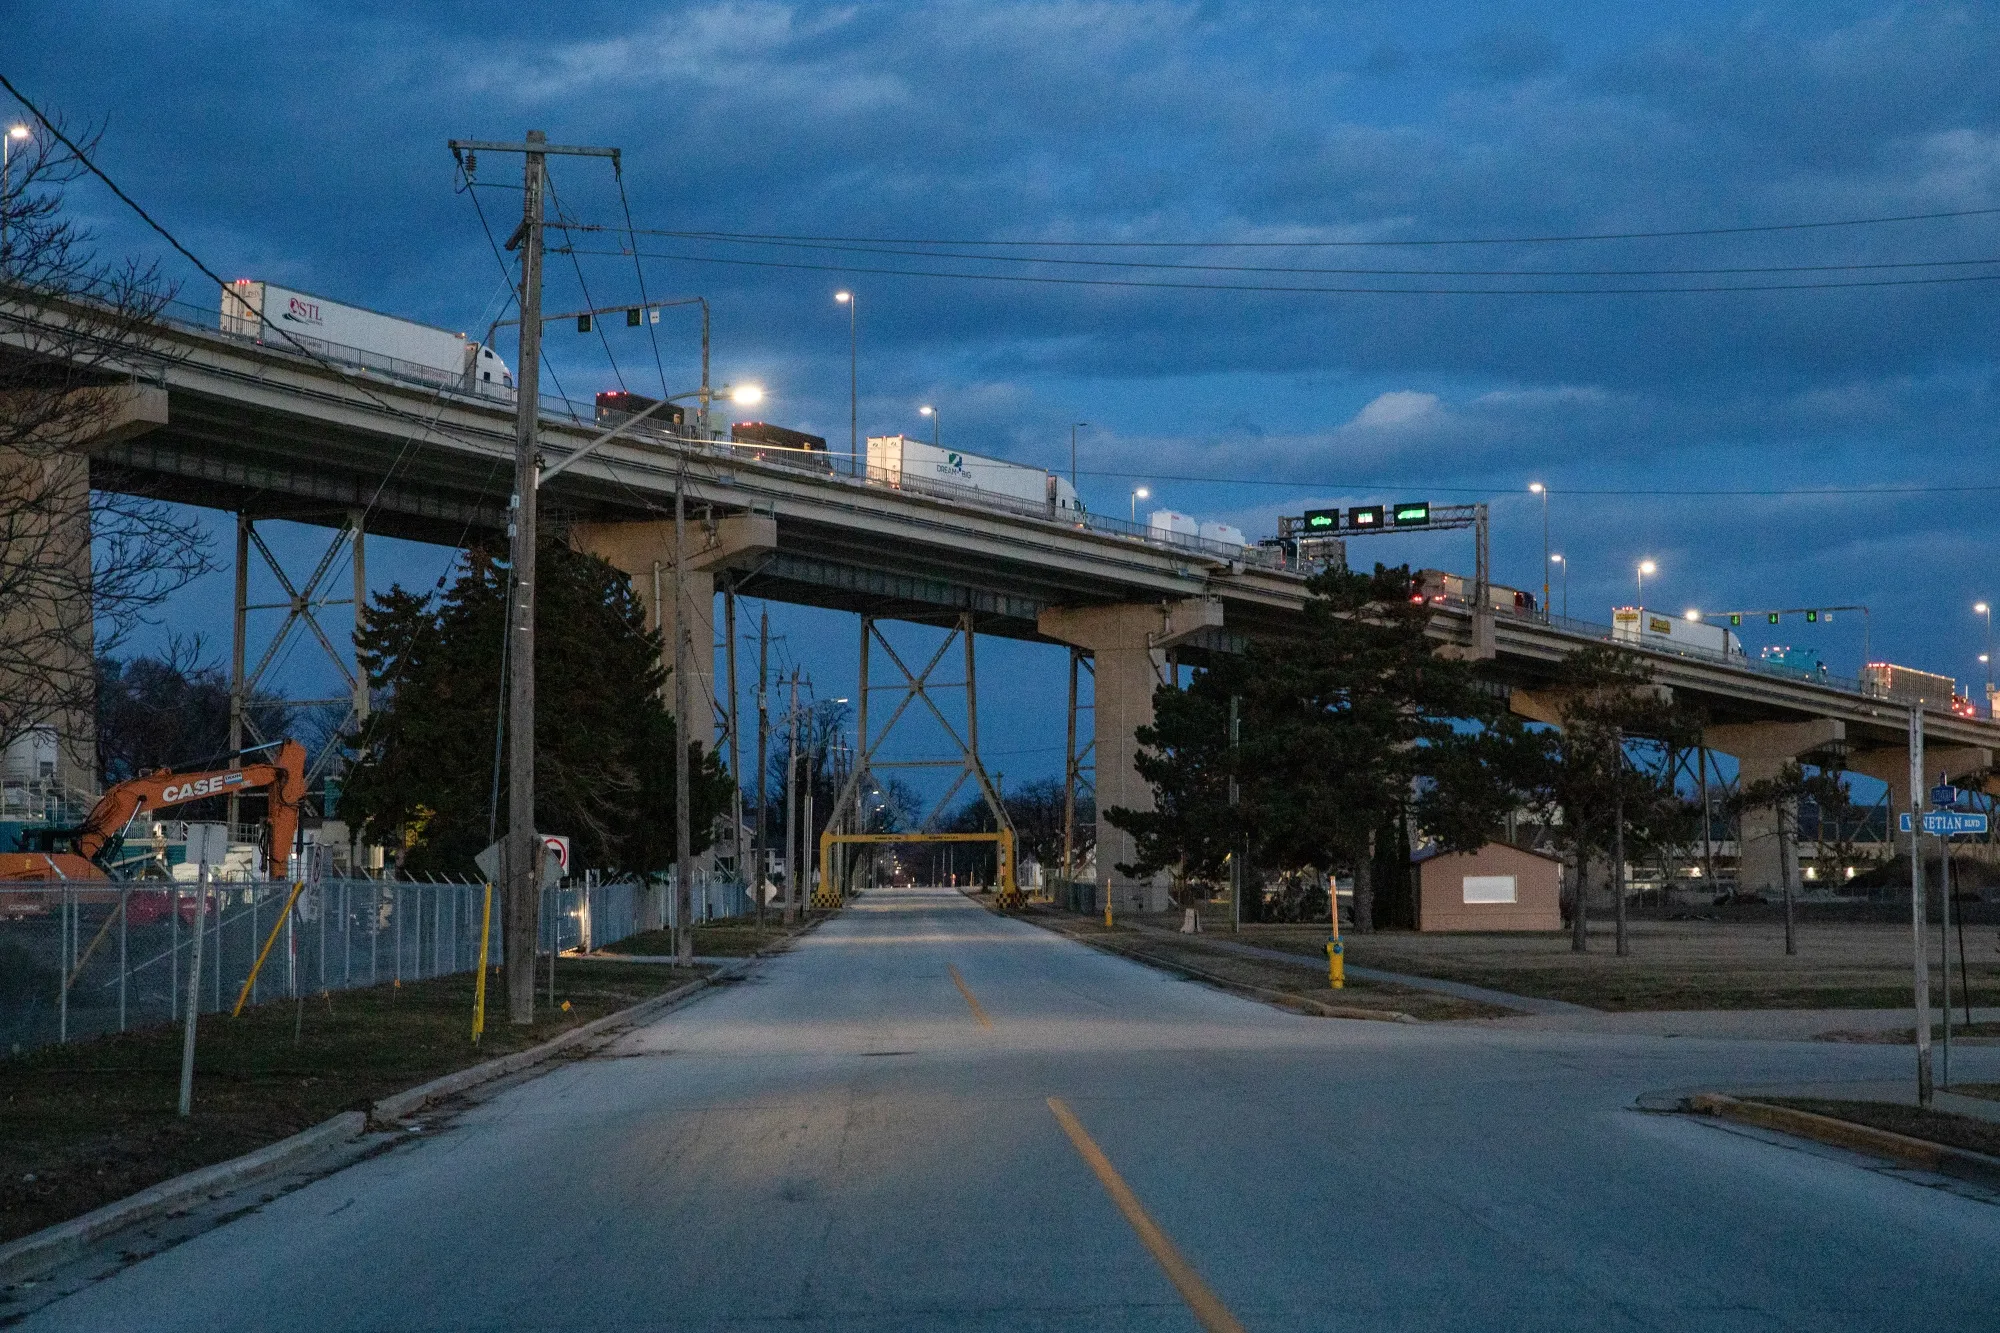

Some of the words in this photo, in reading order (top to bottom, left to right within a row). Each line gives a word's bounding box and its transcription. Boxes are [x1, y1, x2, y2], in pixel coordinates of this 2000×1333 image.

[961, 470, 972, 479] BIG
[162, 775, 223, 802] CASE
[1906, 816, 1962, 830] VNETIAN
[1964, 819, 1981, 828] BLVD
